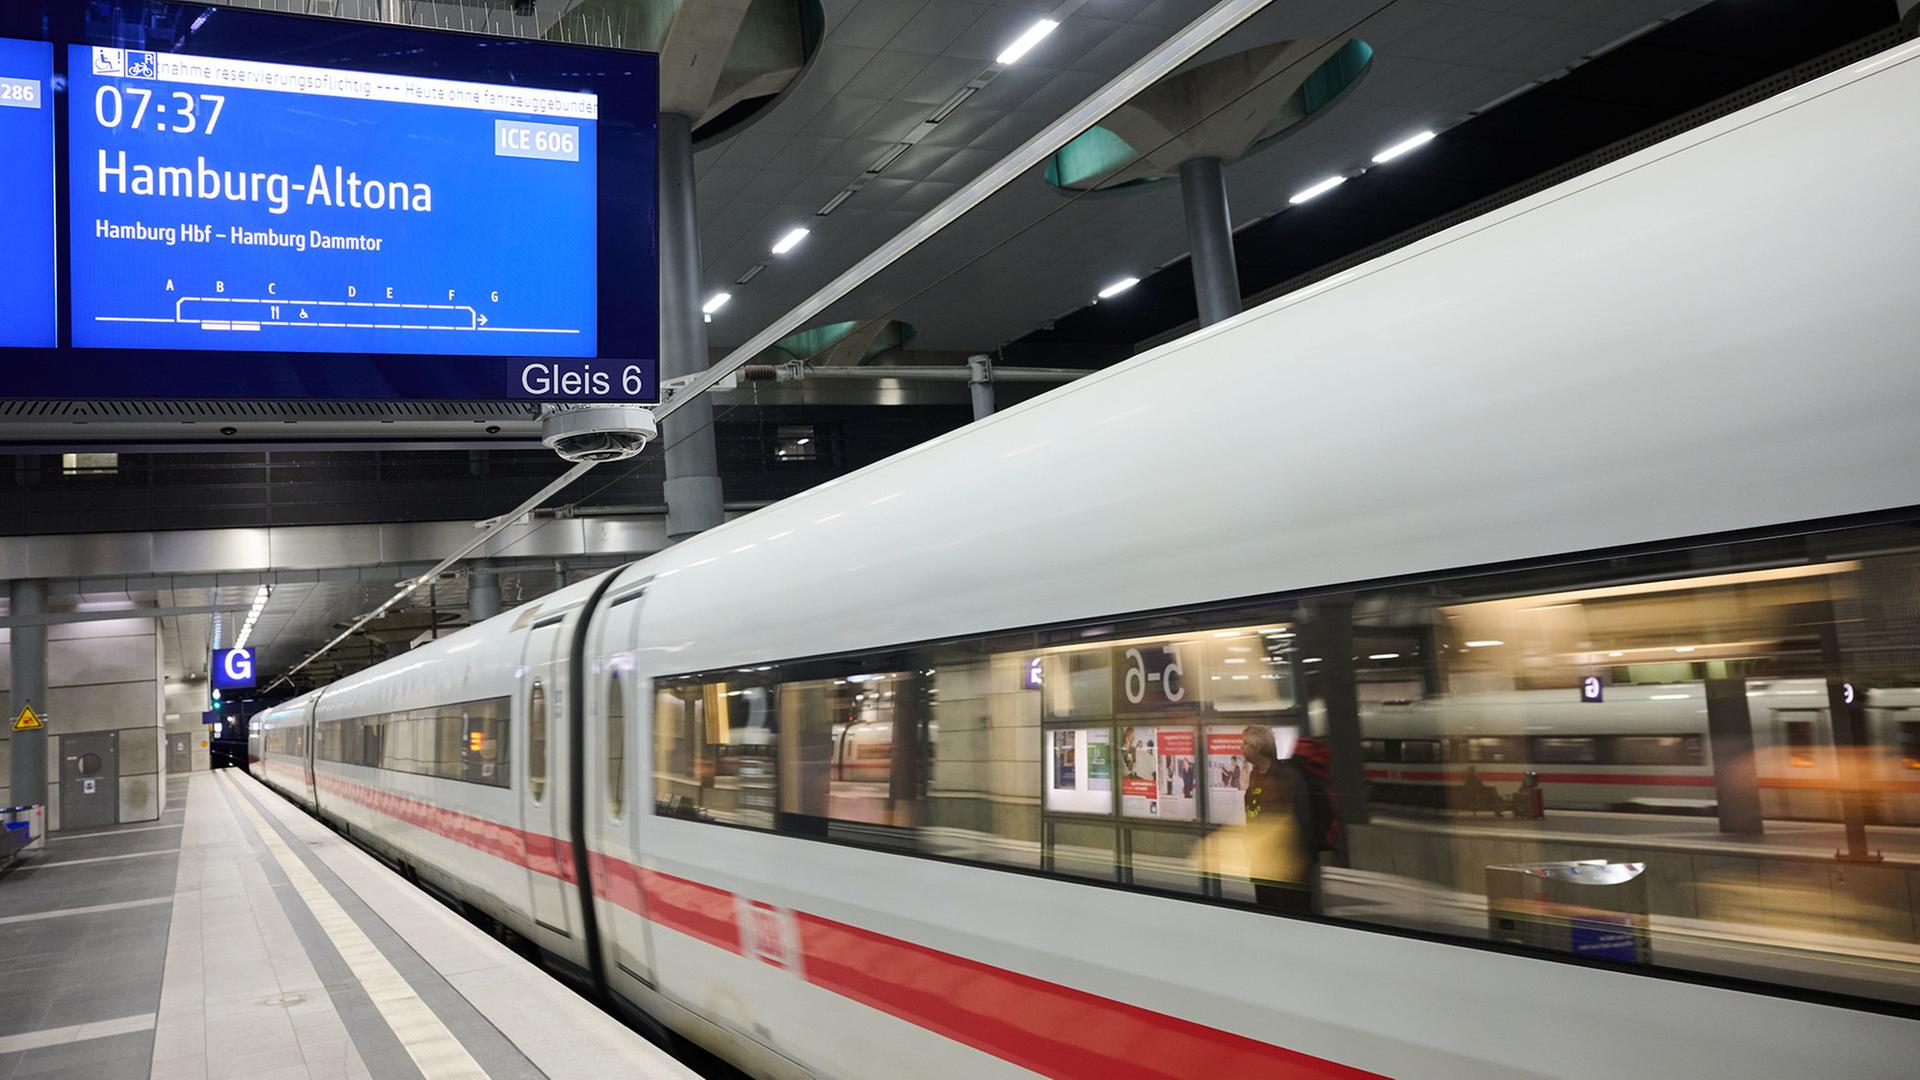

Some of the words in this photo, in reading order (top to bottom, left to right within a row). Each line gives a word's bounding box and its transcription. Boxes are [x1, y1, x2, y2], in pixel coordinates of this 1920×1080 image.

[158, 61, 212, 79] nahme
[216, 68, 371, 97] reservierungspflichtig
[405, 81, 445, 101] Heute
[449, 87, 480, 104] ohne
[95, 85, 225, 135] 07:37
[501, 127, 531, 150] ICE
[535, 130, 574, 153] 606
[98, 149, 432, 215] Hamburg-Altona
[96, 219, 176, 246] Hamburg
[180, 223, 212, 243] Hbf
[231, 226, 305, 252] Hamburg
[310, 230, 383, 251] Dammtor
[165, 279, 174, 291] A
[216, 281, 225, 293] B
[268, 282, 276, 295] C
[348, 286, 356, 298] D
[386, 287, 393, 299] E
[448, 289, 455, 301] F
[491, 291, 498, 302] G
[521, 363, 611, 395] Gleis
[622, 365, 642, 395] 6
[224, 649, 251, 680] G
